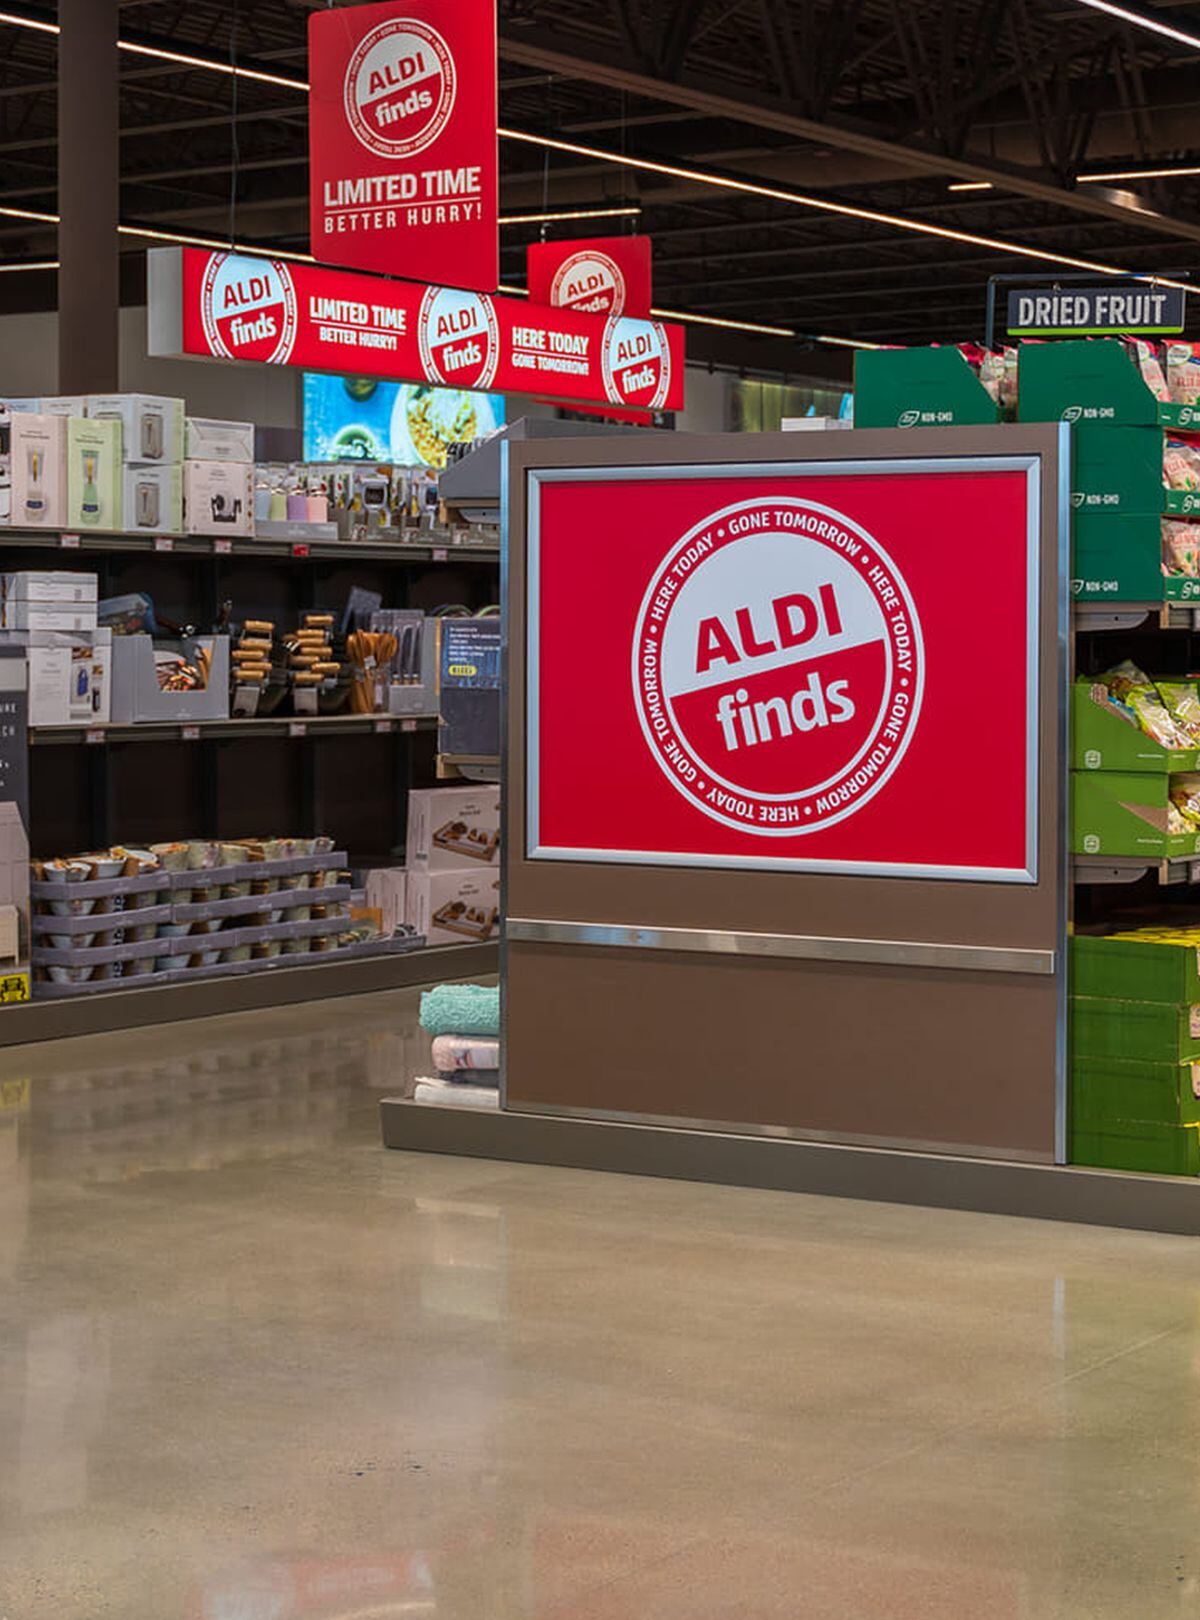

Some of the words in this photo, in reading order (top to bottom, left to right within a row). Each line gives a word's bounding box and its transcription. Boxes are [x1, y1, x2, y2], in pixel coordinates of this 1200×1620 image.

[369, 52, 425, 94] ALDI
[375, 90, 433, 127] finds
[324, 173, 417, 206] LIMITED
[421, 167, 481, 197] TIME
[325, 211, 396, 233] BETTER
[407, 203, 482, 226] HURRY!
[223, 275, 271, 308] ALDI
[567, 273, 605, 298] ALDI
[310, 296, 368, 325] LIMITED
[371, 305, 407, 330] TIME
[437, 307, 477, 338] ALDI
[1019, 297, 1090, 326] DRIED
[1095, 294, 1167, 324] FRUIT
[230, 313, 277, 346] finds
[319, 326, 356, 344] BETTER
[359, 332, 397, 350] HURRY!
[512, 326, 546, 350] HERE
[547, 331, 589, 355] TODAY
[443, 341, 482, 372] finds
[511, 353, 536, 369] GONE
[617, 334, 652, 363] ALDI
[622, 365, 655, 394] finds
[728, 511, 770, 534] GONE
[774, 511, 861, 557] TOMORROW
[651, 577, 677, 622] HERE
[672, 533, 713, 576] TODAY
[696, 583, 842, 674] ALDI
[868, 566, 900, 613] HERE
[890, 611, 912, 671] TODAY
[643, 639, 671, 740] TOMORROW
[717, 672, 855, 751] finds
[883, 692, 908, 741] GONE
[664, 740, 696, 782] GONE
[817, 740, 891, 814] TOMORROW
[706, 788, 754, 819] TODAY
[759, 806, 799, 821] HERE
